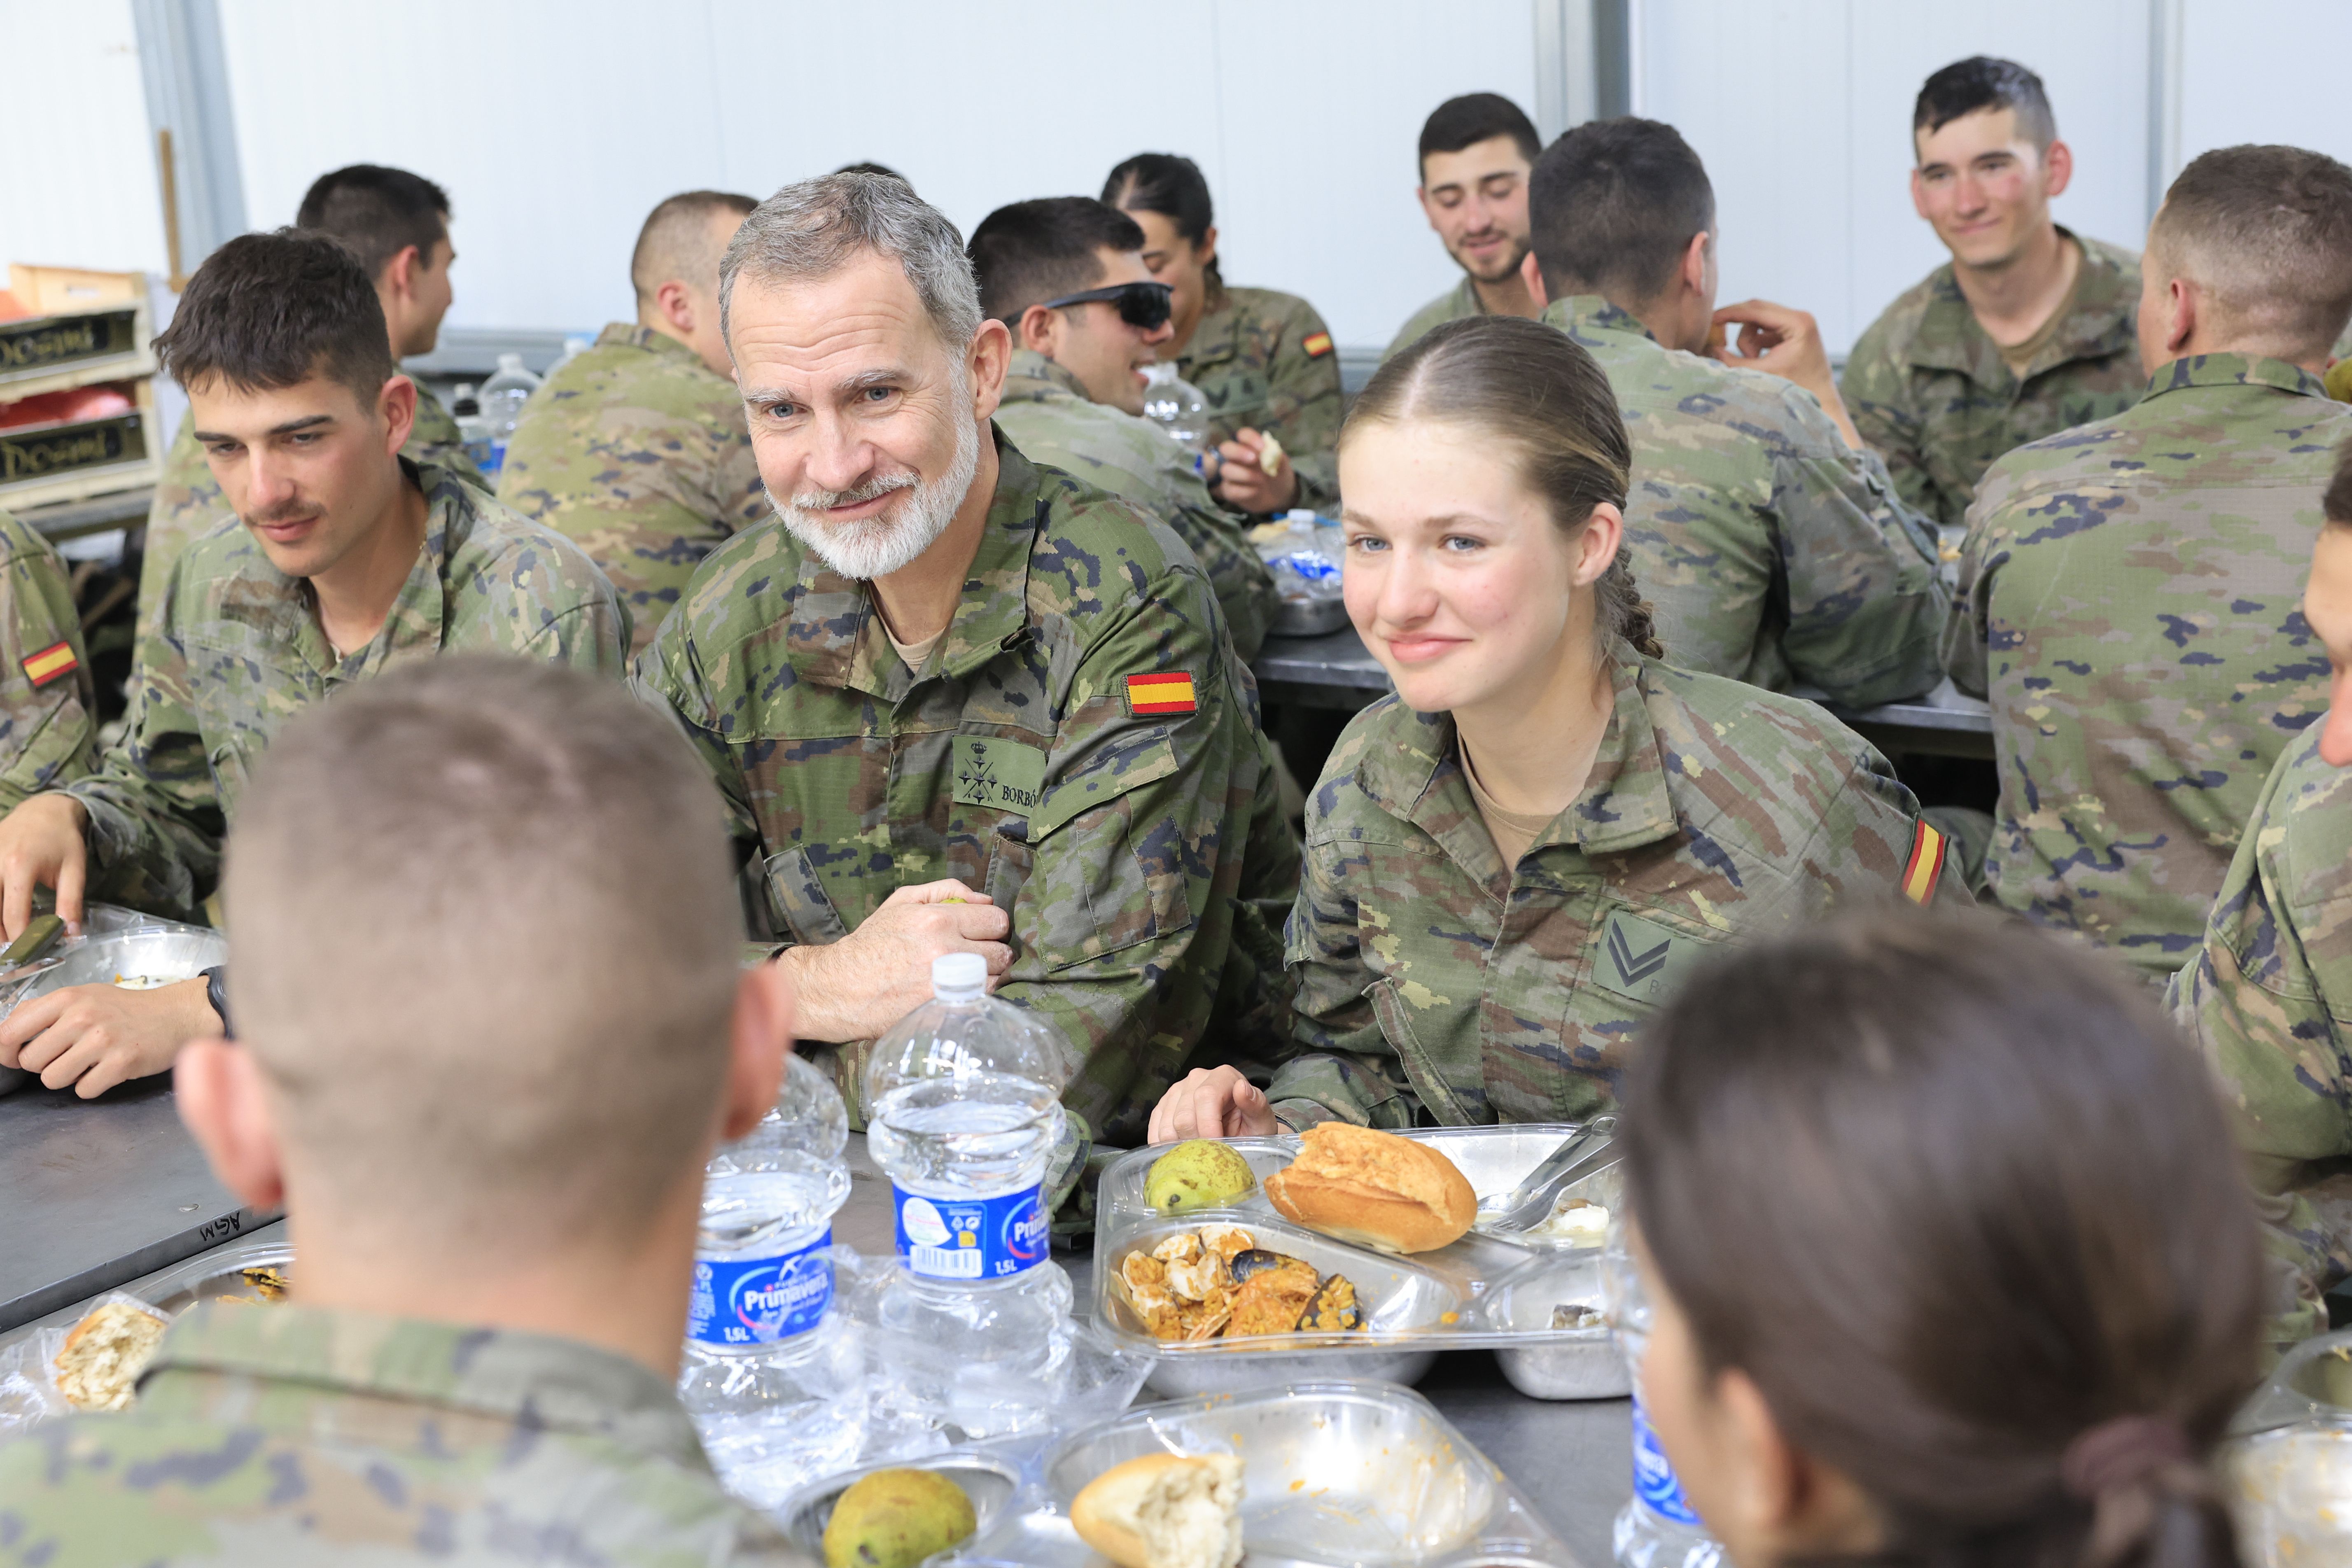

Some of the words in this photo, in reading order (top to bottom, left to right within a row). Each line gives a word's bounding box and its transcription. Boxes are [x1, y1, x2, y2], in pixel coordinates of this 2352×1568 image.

[1002, 784, 1038, 808] BORBÓ
[200, 1211, 240, 1241] AGM
[744, 1272, 828, 1311] Primavera
